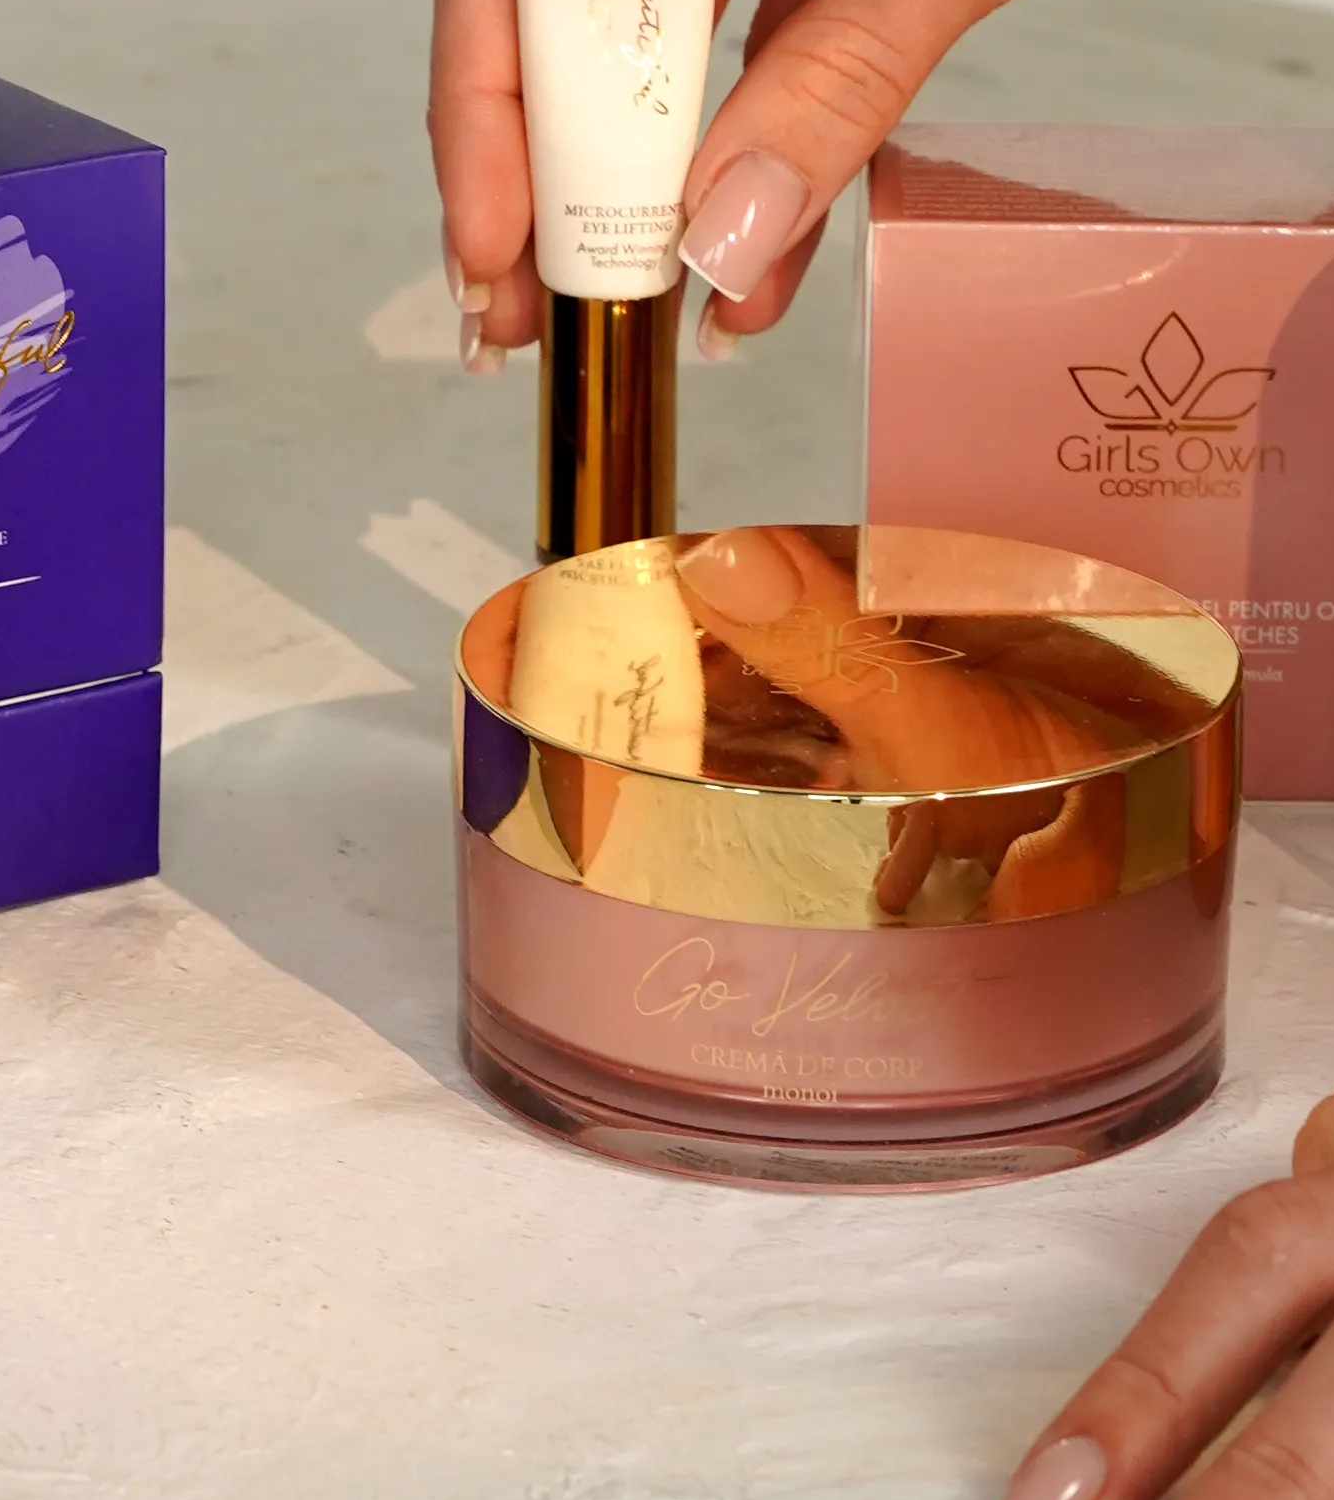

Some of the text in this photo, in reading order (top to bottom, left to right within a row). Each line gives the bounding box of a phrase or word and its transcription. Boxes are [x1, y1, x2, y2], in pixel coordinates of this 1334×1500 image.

[581, 219, 674, 235] EYE LIFTING
[576, 242, 619, 256] Award
[591, 256, 658, 272] Technology
[1056, 433, 1285, 475] Girls Own
[1099, 473, 1242, 499] cosmetics
[1200, 599, 1222, 619] EL
[1228, 600, 1311, 621] PENTRU
[1231, 624, 1300, 646] TCHES
[633, 937, 751, 1022] Go
[690, 1043, 924, 1079] CREMĂ DE CORP
